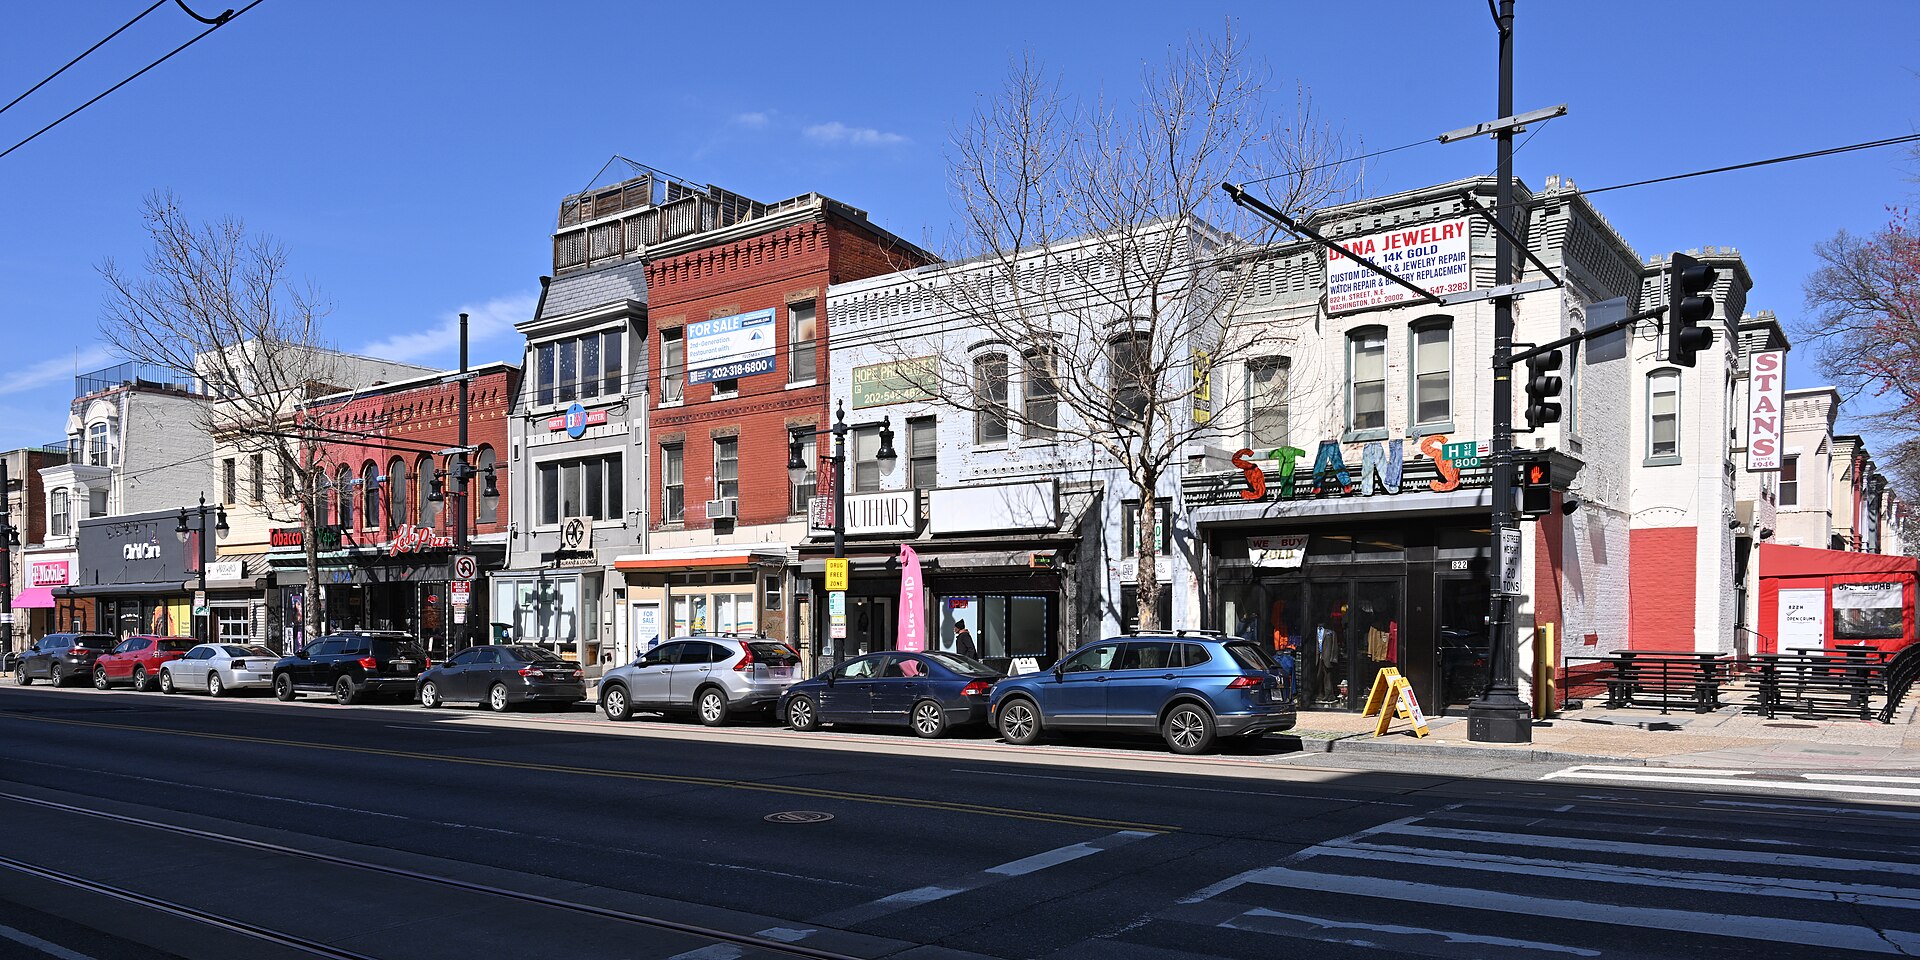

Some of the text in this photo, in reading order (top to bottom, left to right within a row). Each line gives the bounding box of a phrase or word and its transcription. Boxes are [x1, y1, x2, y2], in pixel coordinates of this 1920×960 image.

[1382, 221, 1465, 250] JEWELRY
[1383, 251, 1403, 263] 14K
[1407, 244, 1438, 259] GOLD
[1330, 269, 1359, 283] CUSTOM
[1394, 263, 1400, 273] &
[1402, 256, 1436, 271] JEWELRY
[1438, 252, 1466, 265] REPAIR
[1330, 263, 1467, 295] WATCH REPAIR & BATERY REPLACEMENT
[1330, 295, 1341, 304] 822
[1330, 299, 1370, 311] WASHINGTON,
[1384, 293, 1404, 303] 20002
[689, 321, 711, 338] FOR
[712, 316, 740, 334] SALE
[690, 347, 717, 358] Restaurant
[854, 367, 878, 384] HOPE
[1751, 353, 1779, 457] STAN'S
[548, 419, 564, 428] DIRTY
[587, 413, 605, 422] WATER
[1448, 445, 1459, 458] H
[1454, 457, 1478, 468] 800
[846, 498, 915, 528] AUTEHAIR
[269, 528, 337, 546] Tobacco Vape
[390, 524, 418, 557] Ledo
[1252, 538, 1303, 548] WE BUY
[1507, 534, 1520, 544] STREET
[1504, 545, 1519, 555] WEIGHT
[1452, 560, 1467, 569] 822
[1505, 556, 1518, 566] LIMIT
[1506, 567, 1516, 579] 20
[1503, 580, 1520, 592] TONS
[949, 600, 968, 609] OPEN
